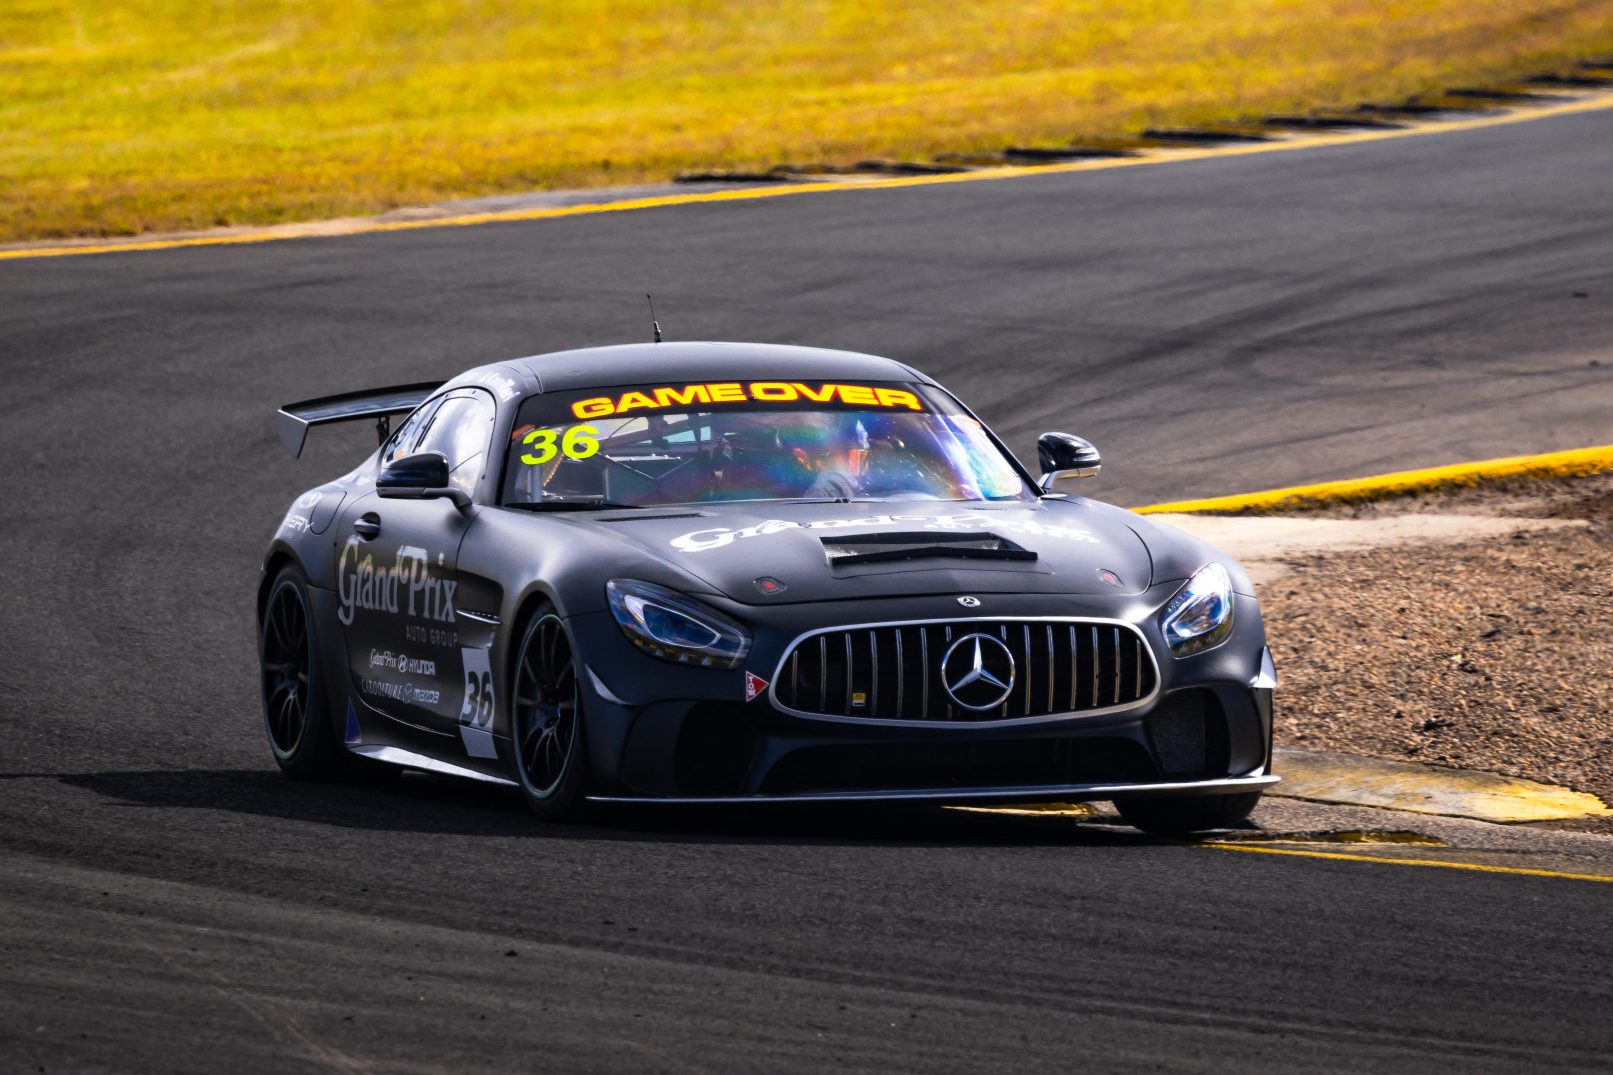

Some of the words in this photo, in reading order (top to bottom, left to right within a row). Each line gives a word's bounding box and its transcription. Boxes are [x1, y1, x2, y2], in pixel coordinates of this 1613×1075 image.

[572, 382, 748, 419] GAME
[749, 382, 923, 411] OVER
[520, 424, 600, 465] 36
[338, 534, 402, 626] Grand
[397, 544, 458, 623] Prix
[406, 624, 427, 643] AUTO
[430, 628, 458, 648] GROUP
[460, 671, 493, 728] 36
[747, 676, 756, 696] TOW
